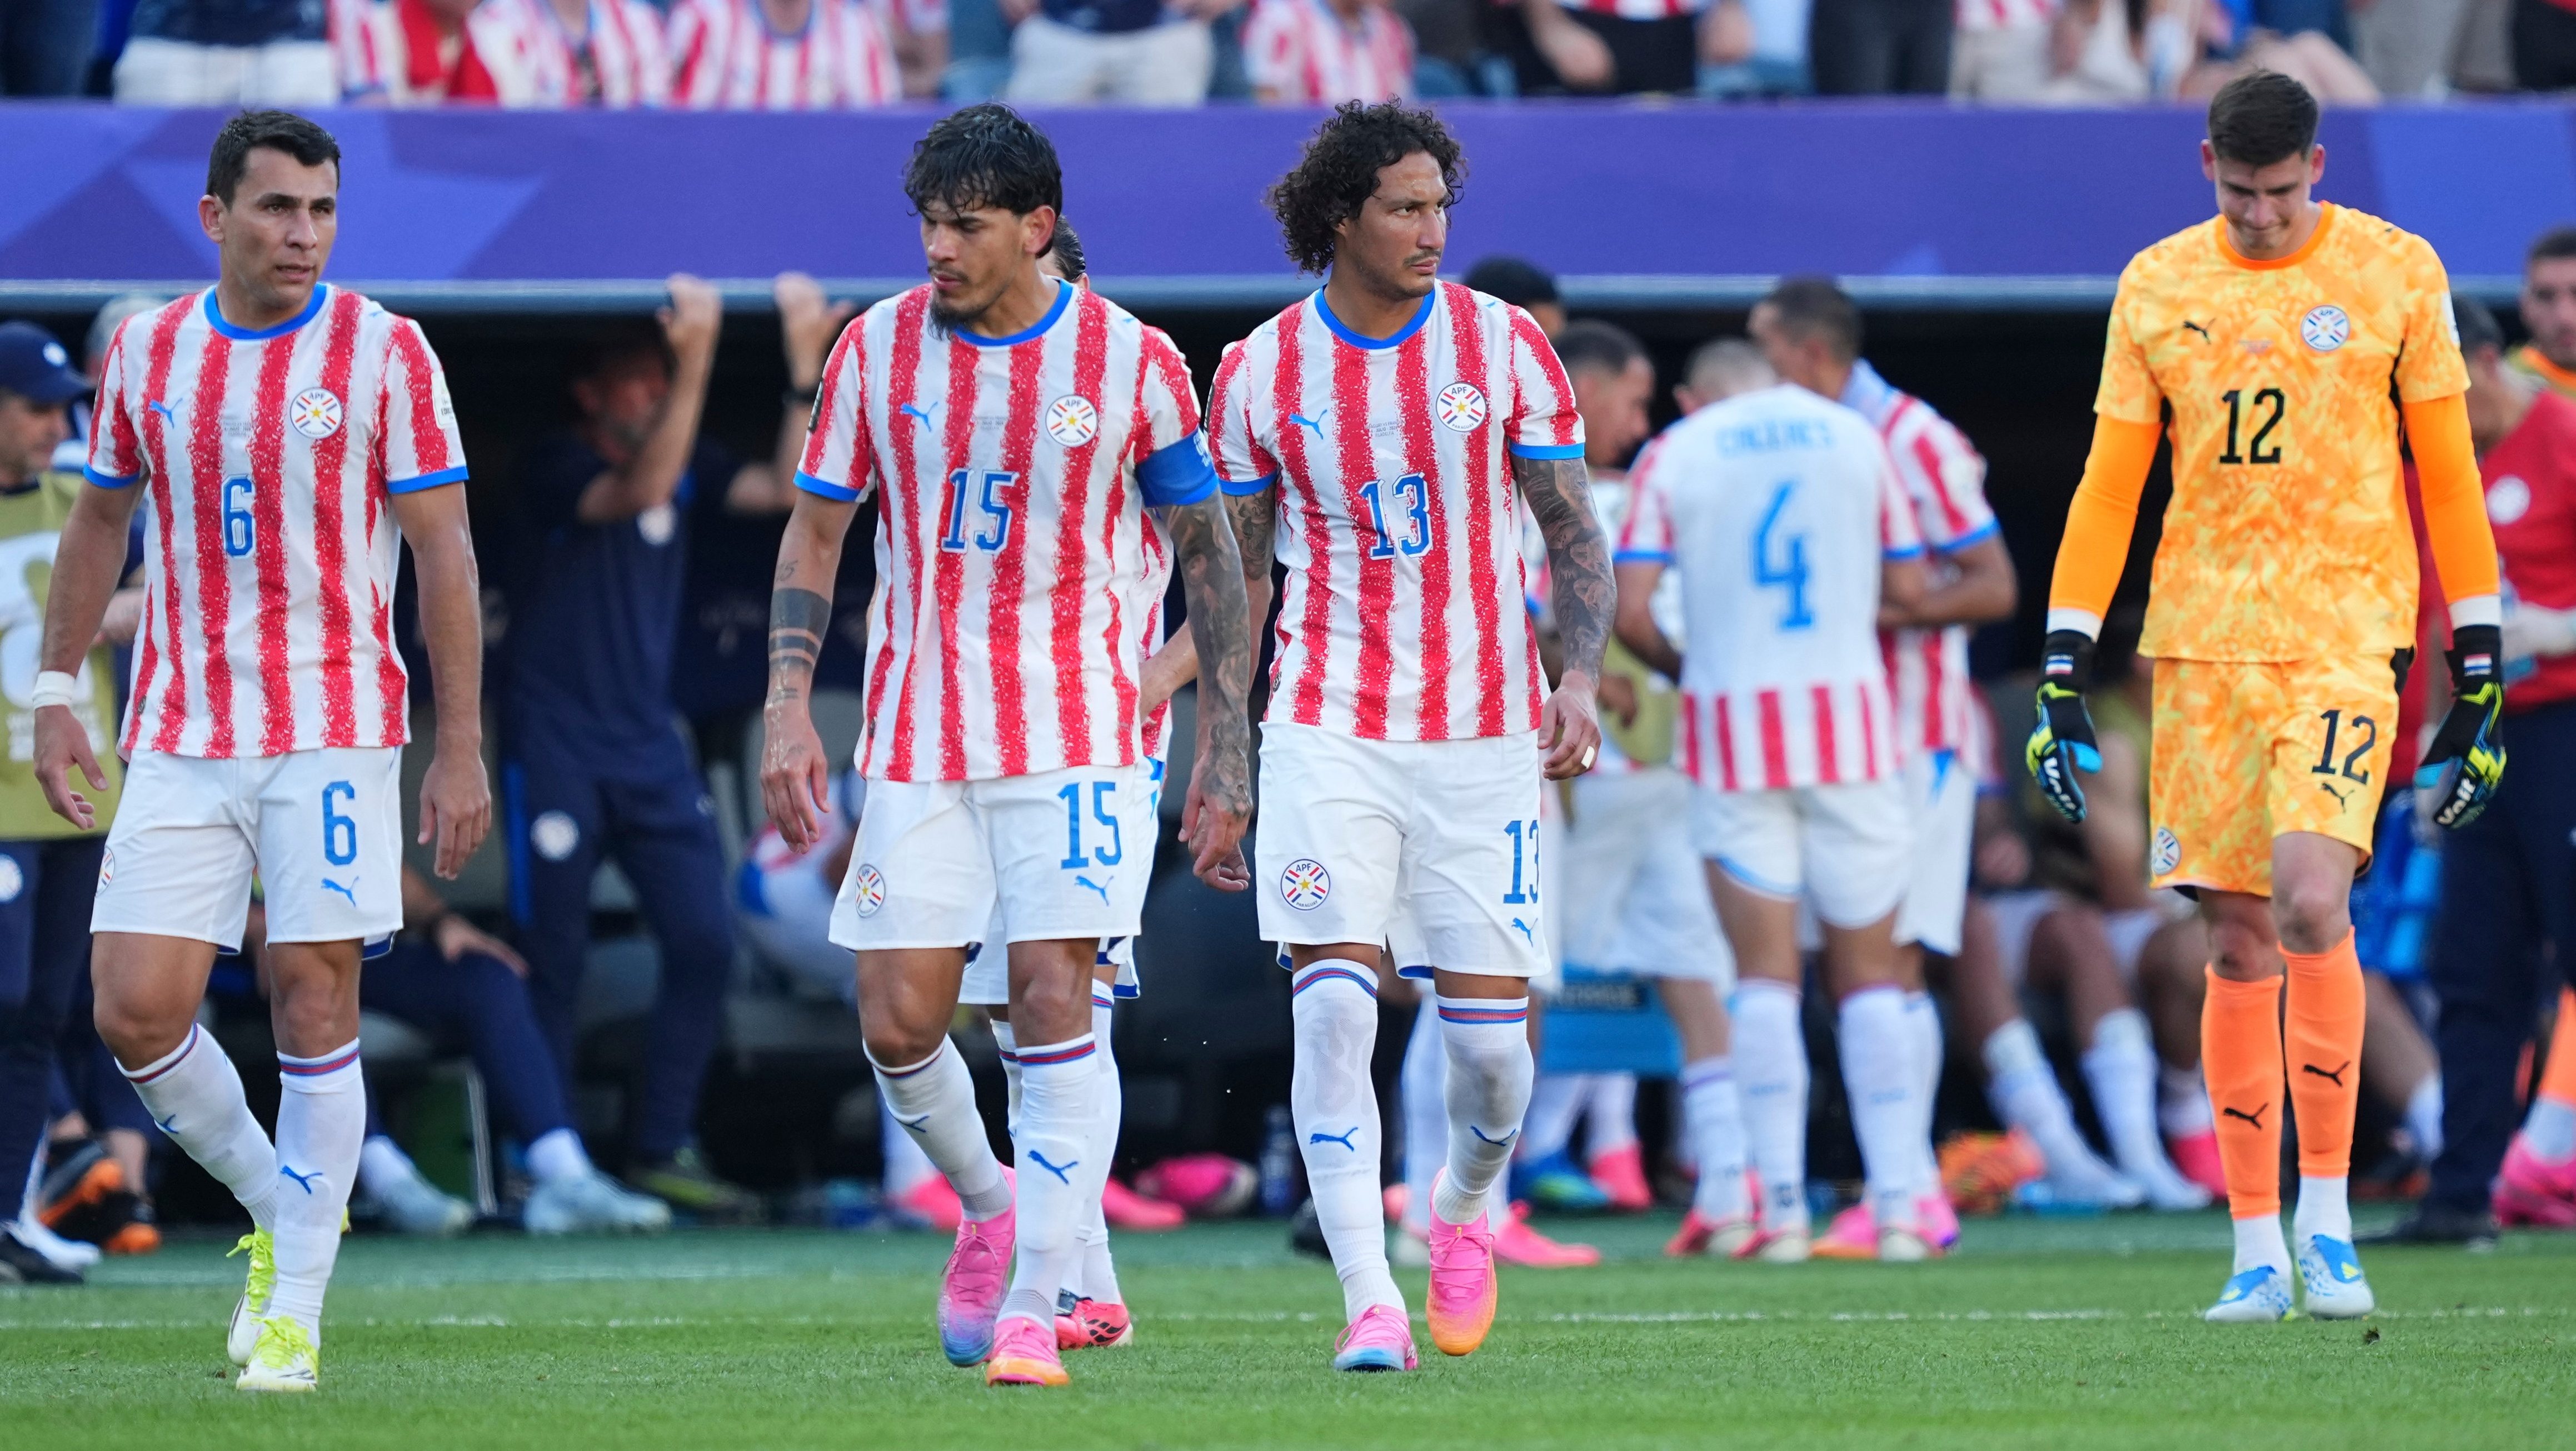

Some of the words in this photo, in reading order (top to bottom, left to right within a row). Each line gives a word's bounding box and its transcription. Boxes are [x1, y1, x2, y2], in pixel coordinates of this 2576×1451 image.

[2219, 387, 2286, 465] 12
[221, 474, 256, 558] 6
[940, 467, 1020, 555] 15
[1357, 472, 1433, 561] 13
[1749, 480, 1815, 631] 4
[2312, 709, 2376, 784] 12
[321, 780, 357, 867] 6
[1057, 781, 1122, 870] 15
[1503, 819, 1539, 904] 13
[1296, 863, 1311, 872] APF
